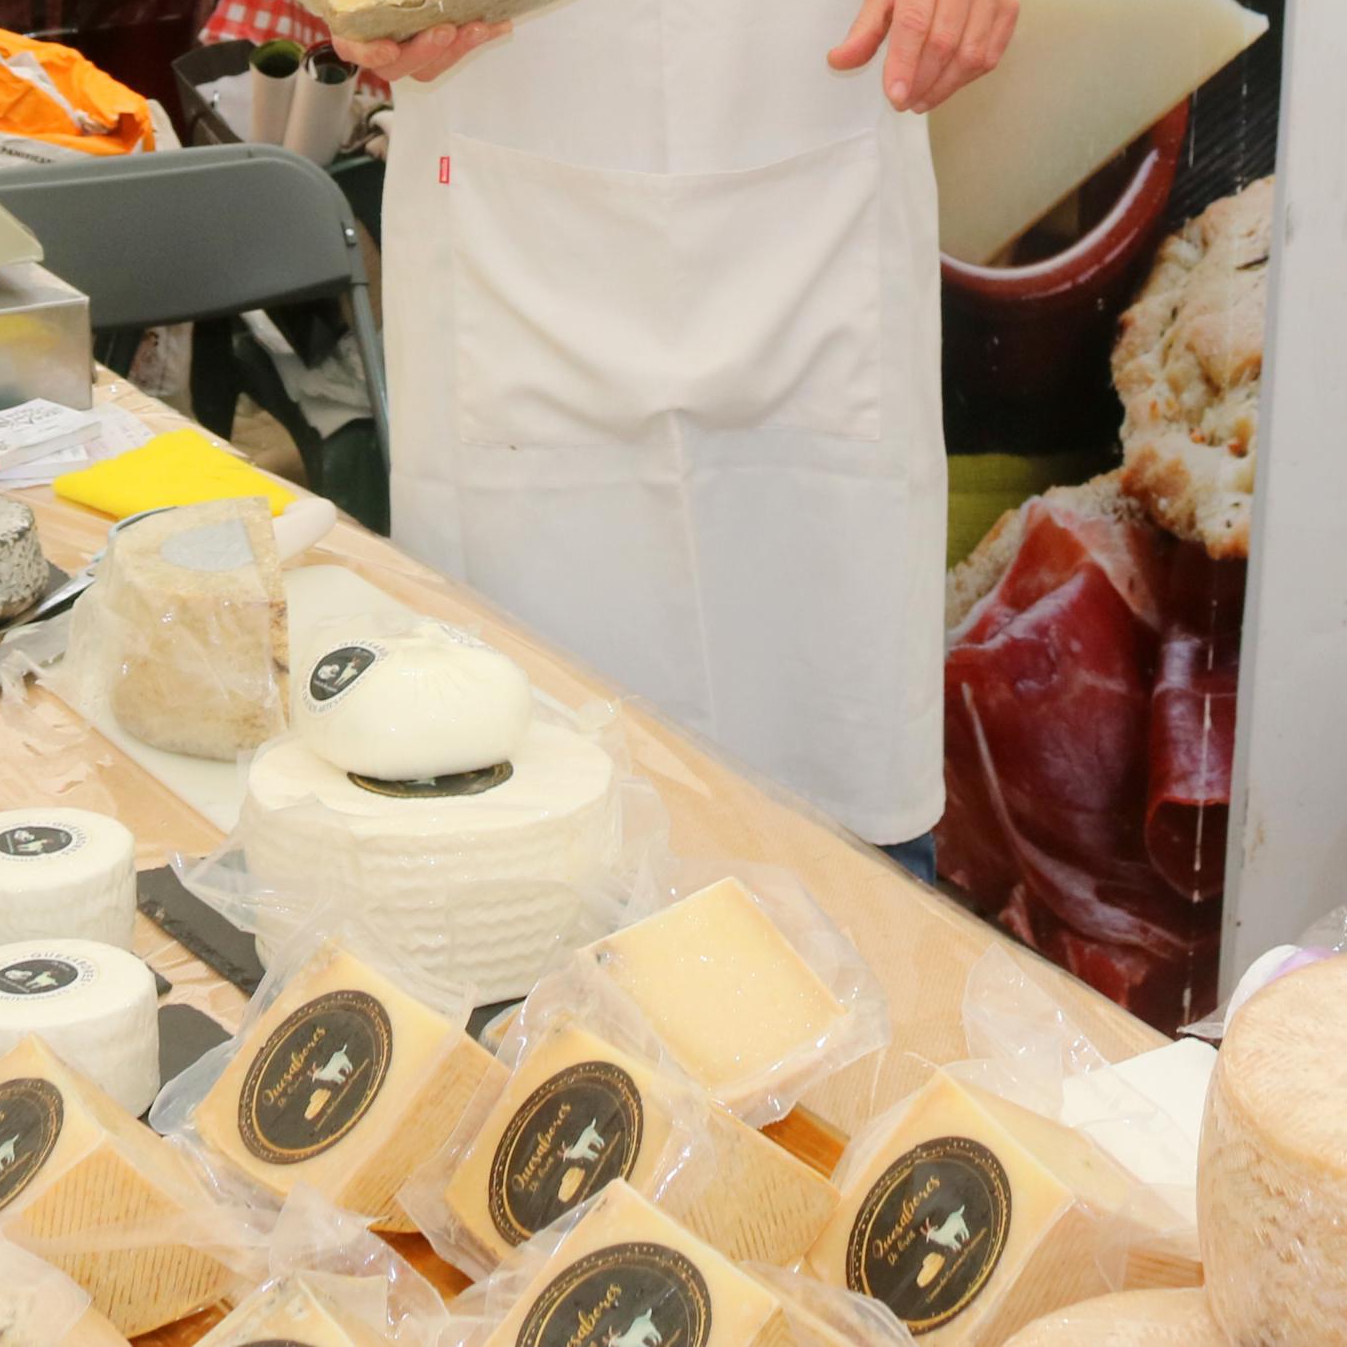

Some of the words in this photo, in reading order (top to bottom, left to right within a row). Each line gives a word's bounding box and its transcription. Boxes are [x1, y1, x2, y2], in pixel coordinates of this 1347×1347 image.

[262, 1026, 327, 1106] Quesabores
[512, 1102, 572, 1191] Quesabores
[872, 1174, 941, 1260] Quesabores
